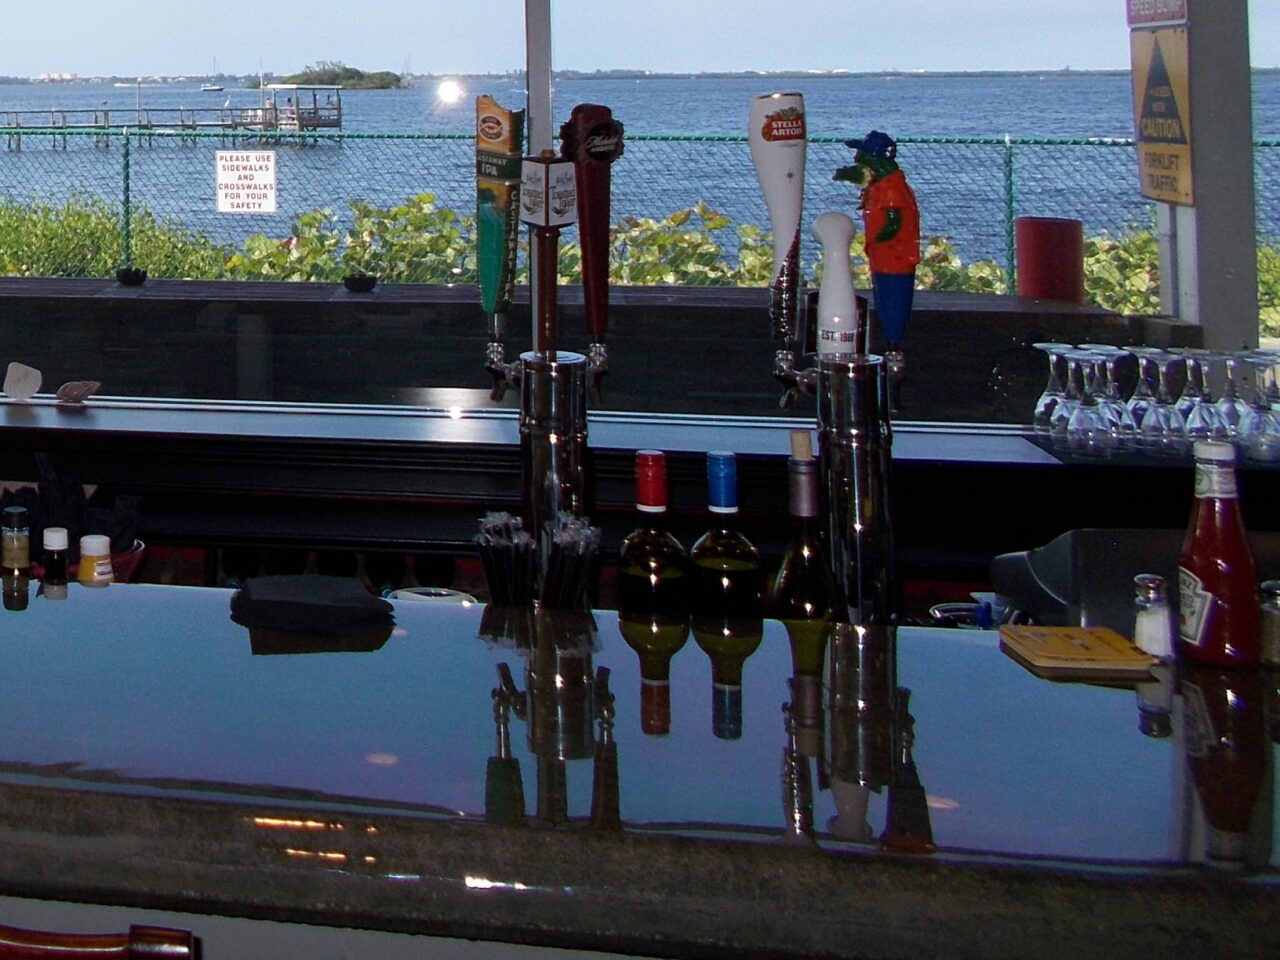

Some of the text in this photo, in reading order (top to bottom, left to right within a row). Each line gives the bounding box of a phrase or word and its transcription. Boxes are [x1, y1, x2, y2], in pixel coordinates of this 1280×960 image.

[771, 120, 803, 129] STELLA
[1141, 117, 1181, 139] CAUTION
[219, 154, 271, 162] PLEASE USE
[1144, 151, 1180, 172] FORKLIFT
[221, 164, 270, 172] SIDEWALKS
[481, 163, 498, 177] IPA
[218, 183, 274, 191] CROSSWALKS
[1146, 173, 1179, 193] TRAFFIC
[224, 192, 268, 200] FOR YOUR
